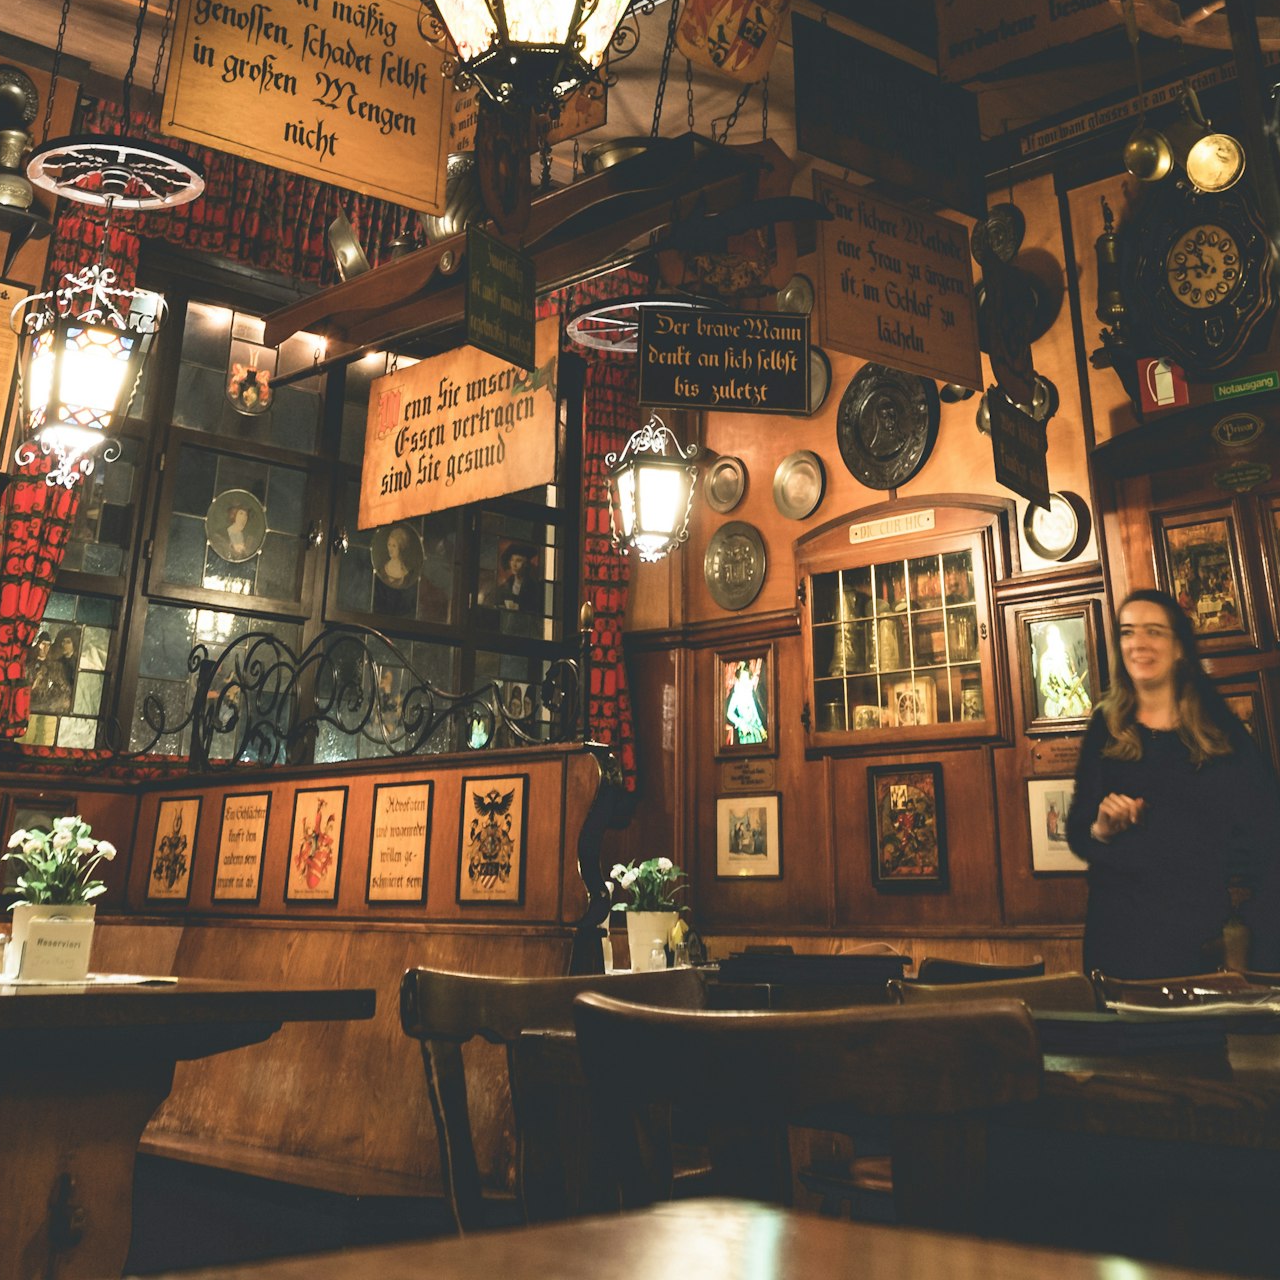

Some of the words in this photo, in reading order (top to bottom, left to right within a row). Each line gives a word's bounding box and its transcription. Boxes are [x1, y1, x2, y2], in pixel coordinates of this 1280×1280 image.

[332, 2, 398, 47] mäßig
[302, 24, 373, 74] schadet
[380, 51, 427, 99] selbst
[193, 36, 214, 68] in
[222, 54, 297, 96] großen
[312, 72, 416, 135] Mengen
[284, 118, 339, 162] nicht
[837, 236, 861, 260] eine
[866, 241, 901, 273] Frau
[906, 262, 919, 283] zu
[654, 313, 690, 335] Der
[697, 316, 740, 338] brave
[743, 317, 801, 340] Mann
[862, 279, 879, 302] im
[885, 282, 933, 323] Schlaf
[940, 308, 955, 331] zu
[648, 343, 691, 366] denkt
[698, 352, 719, 367] an
[724, 346, 752, 375] sich
[757, 348, 798, 376] selbst
[437, 377, 460, 411] Sie
[674, 375, 699, 398] bis
[711, 377, 768, 405] zuletzt
[1218, 377, 1273, 396] Notausgang
[395, 424, 444, 457] Essen
[453, 395, 534, 441] vertragen
[381, 460, 411, 495] sind
[416, 453, 440, 490] Sie
[37, 938, 80, 948] Reserviert
